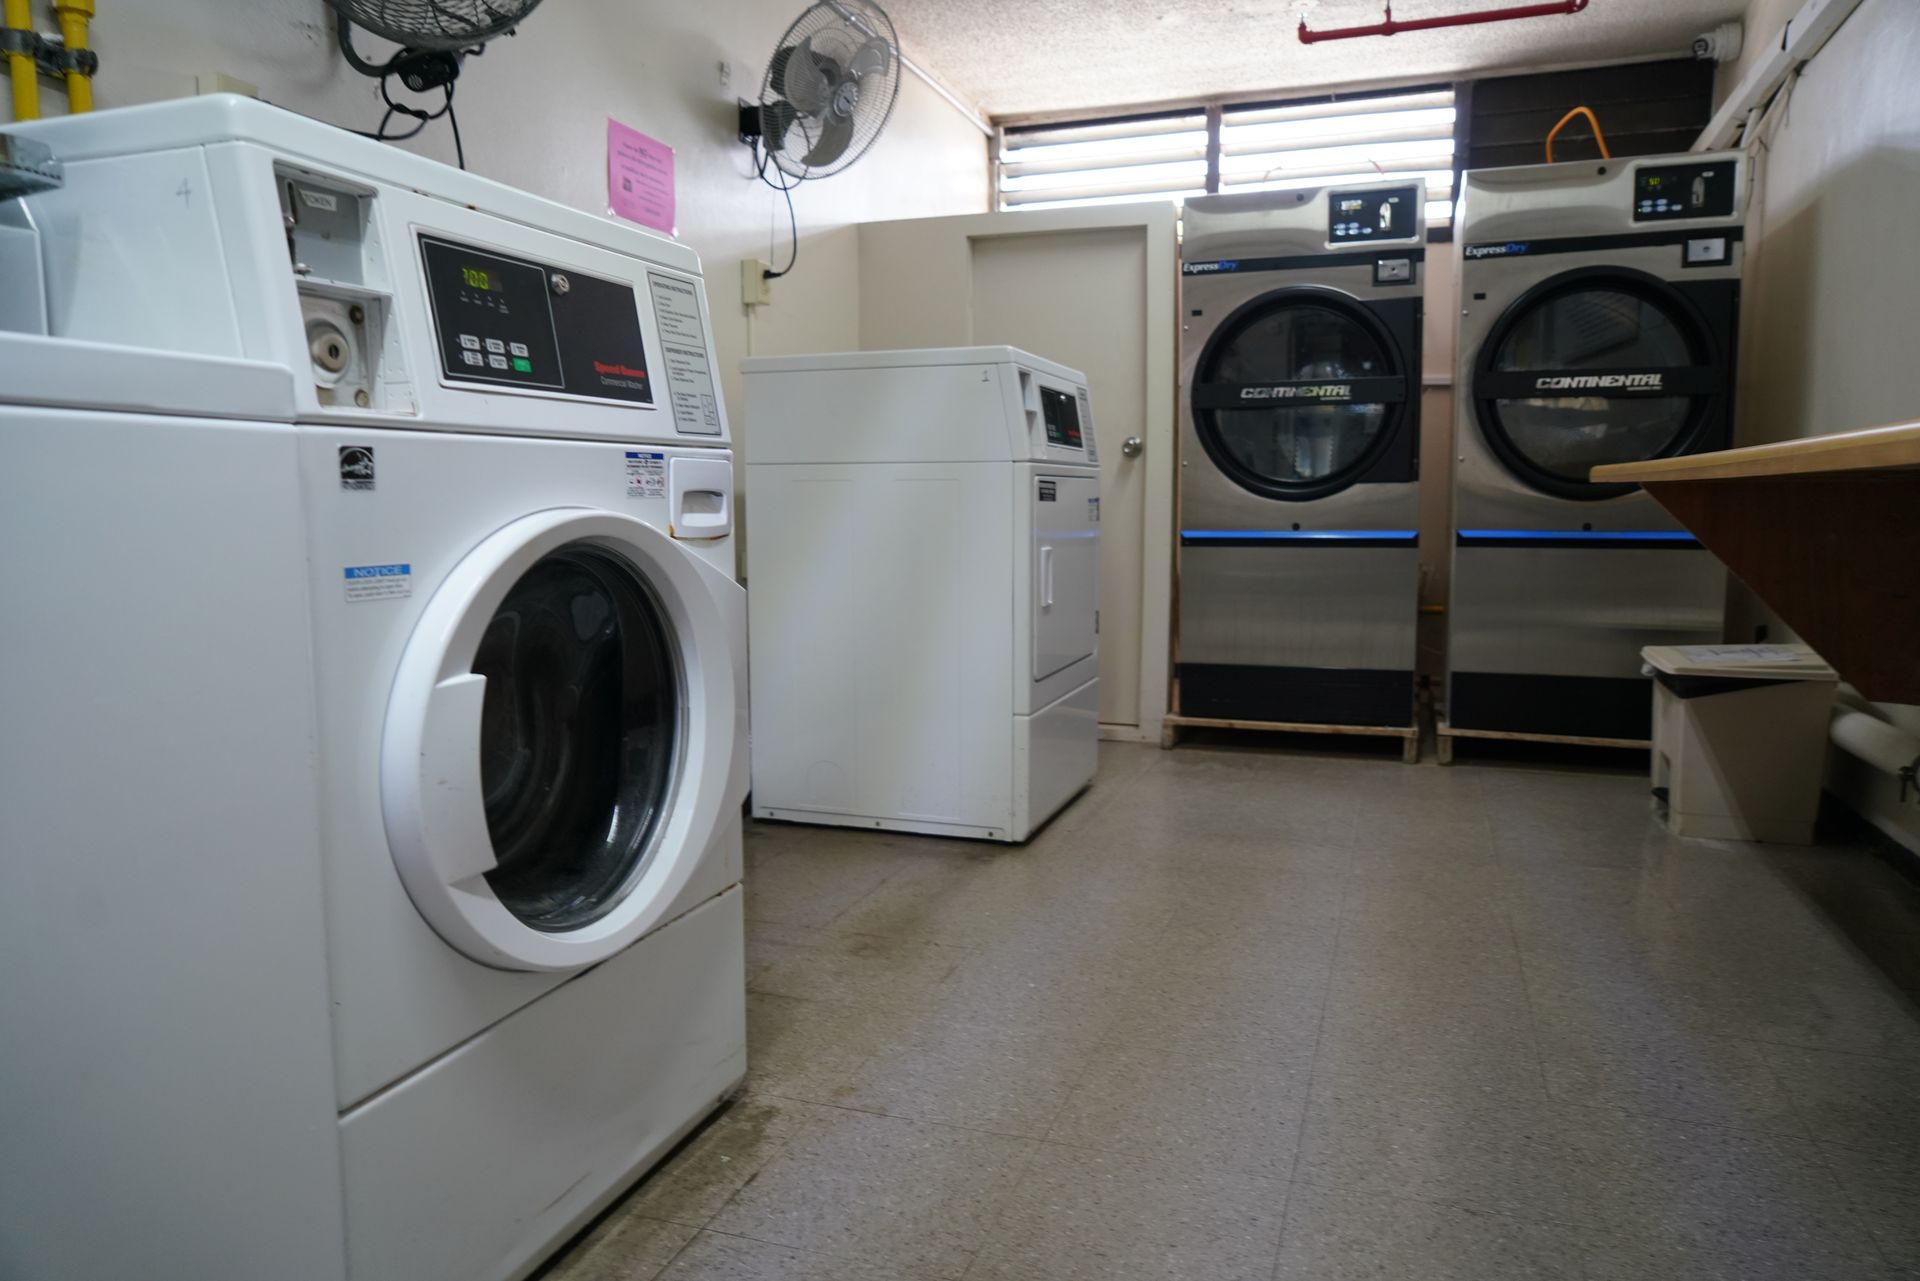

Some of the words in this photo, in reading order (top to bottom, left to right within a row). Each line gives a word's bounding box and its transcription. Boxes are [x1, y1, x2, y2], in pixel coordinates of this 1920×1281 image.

[1536, 373, 1662, 389] CONTINENTAL
[1240, 385, 1352, 399] CONTINENTAL
[353, 566, 402, 578] NOTICE
